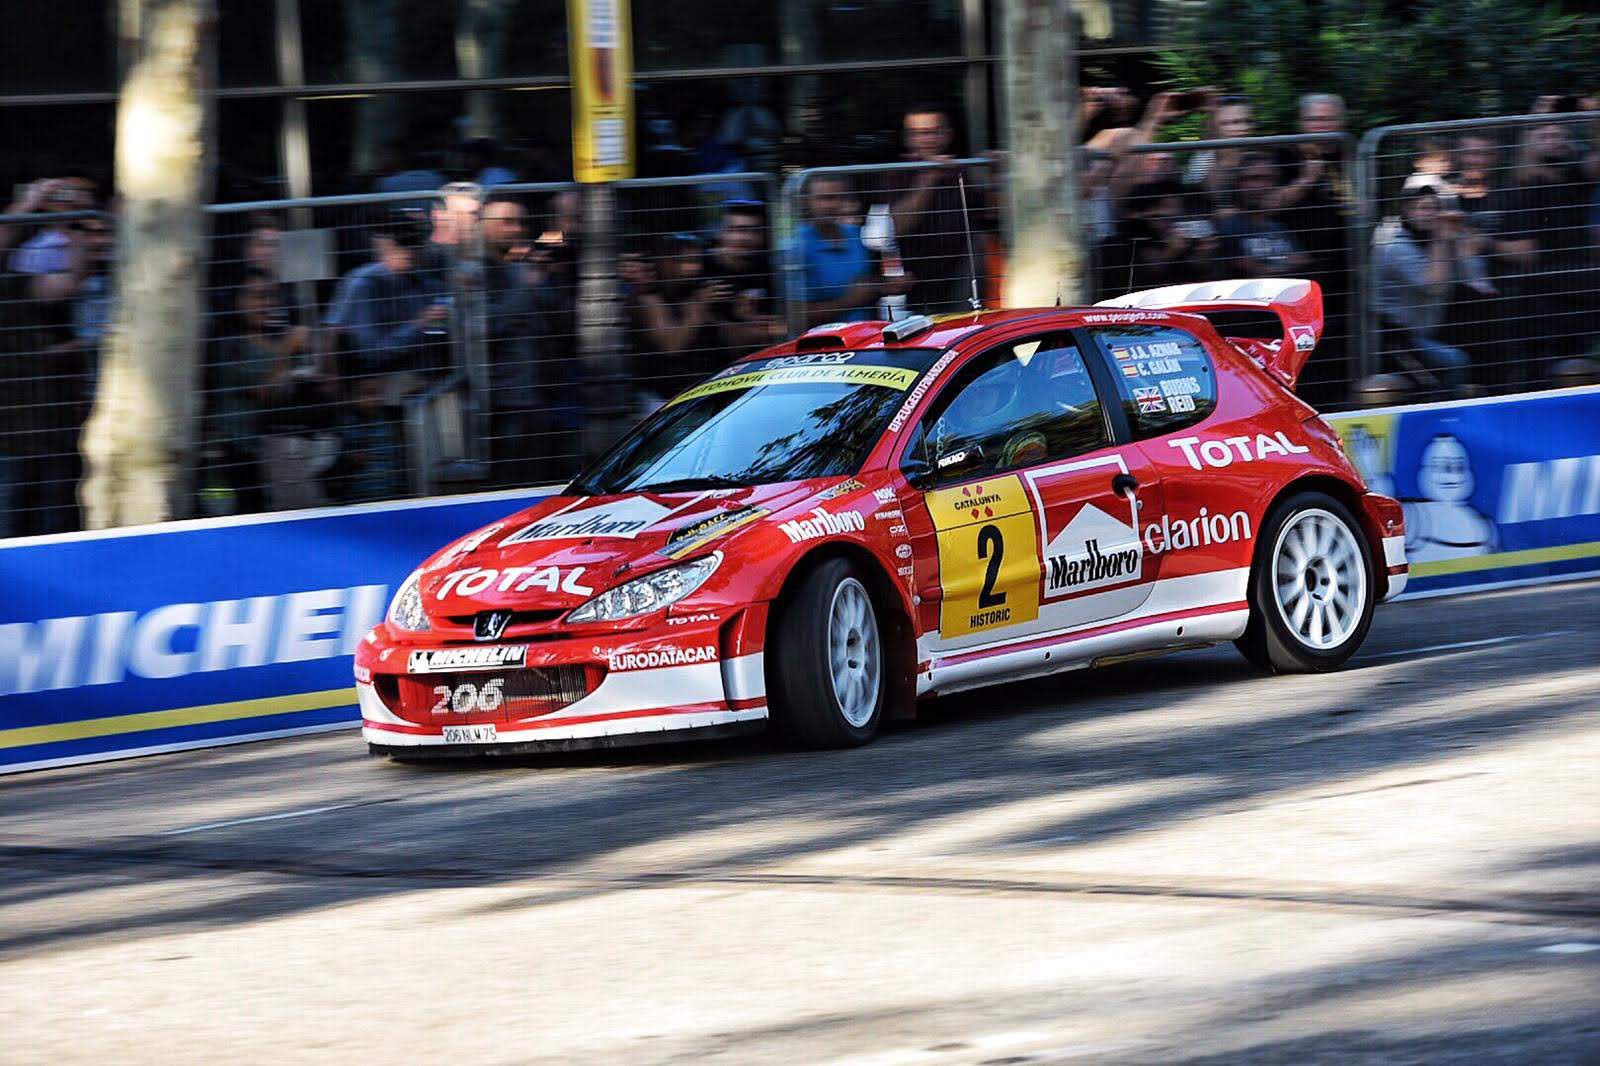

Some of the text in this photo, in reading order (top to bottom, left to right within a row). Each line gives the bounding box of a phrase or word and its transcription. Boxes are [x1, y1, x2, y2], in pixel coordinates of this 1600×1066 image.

[758, 351, 856, 371] sparco
[837, 369, 906, 384] ALMERÍA
[1166, 394, 1196, 414] REID
[1167, 431, 1309, 471] TOTAL
[954, 493, 1002, 511] CATALUNYA
[508, 514, 648, 543] Marlboro
[777, 506, 866, 544] Marlboro
[1144, 507, 1252, 555] clarion
[977, 524, 1007, 610] 2
[1048, 538, 1139, 590] Marlboro
[435, 566, 594, 600] TOTAL
[665, 613, 720, 626] TOTAL
[969, 608, 1012, 629] HISTORIC
[608, 645, 717, 671] EURODATACAR
[430, 678, 505, 714] 206
[443, 728, 462, 744] 206
[483, 726, 498, 741] 75
